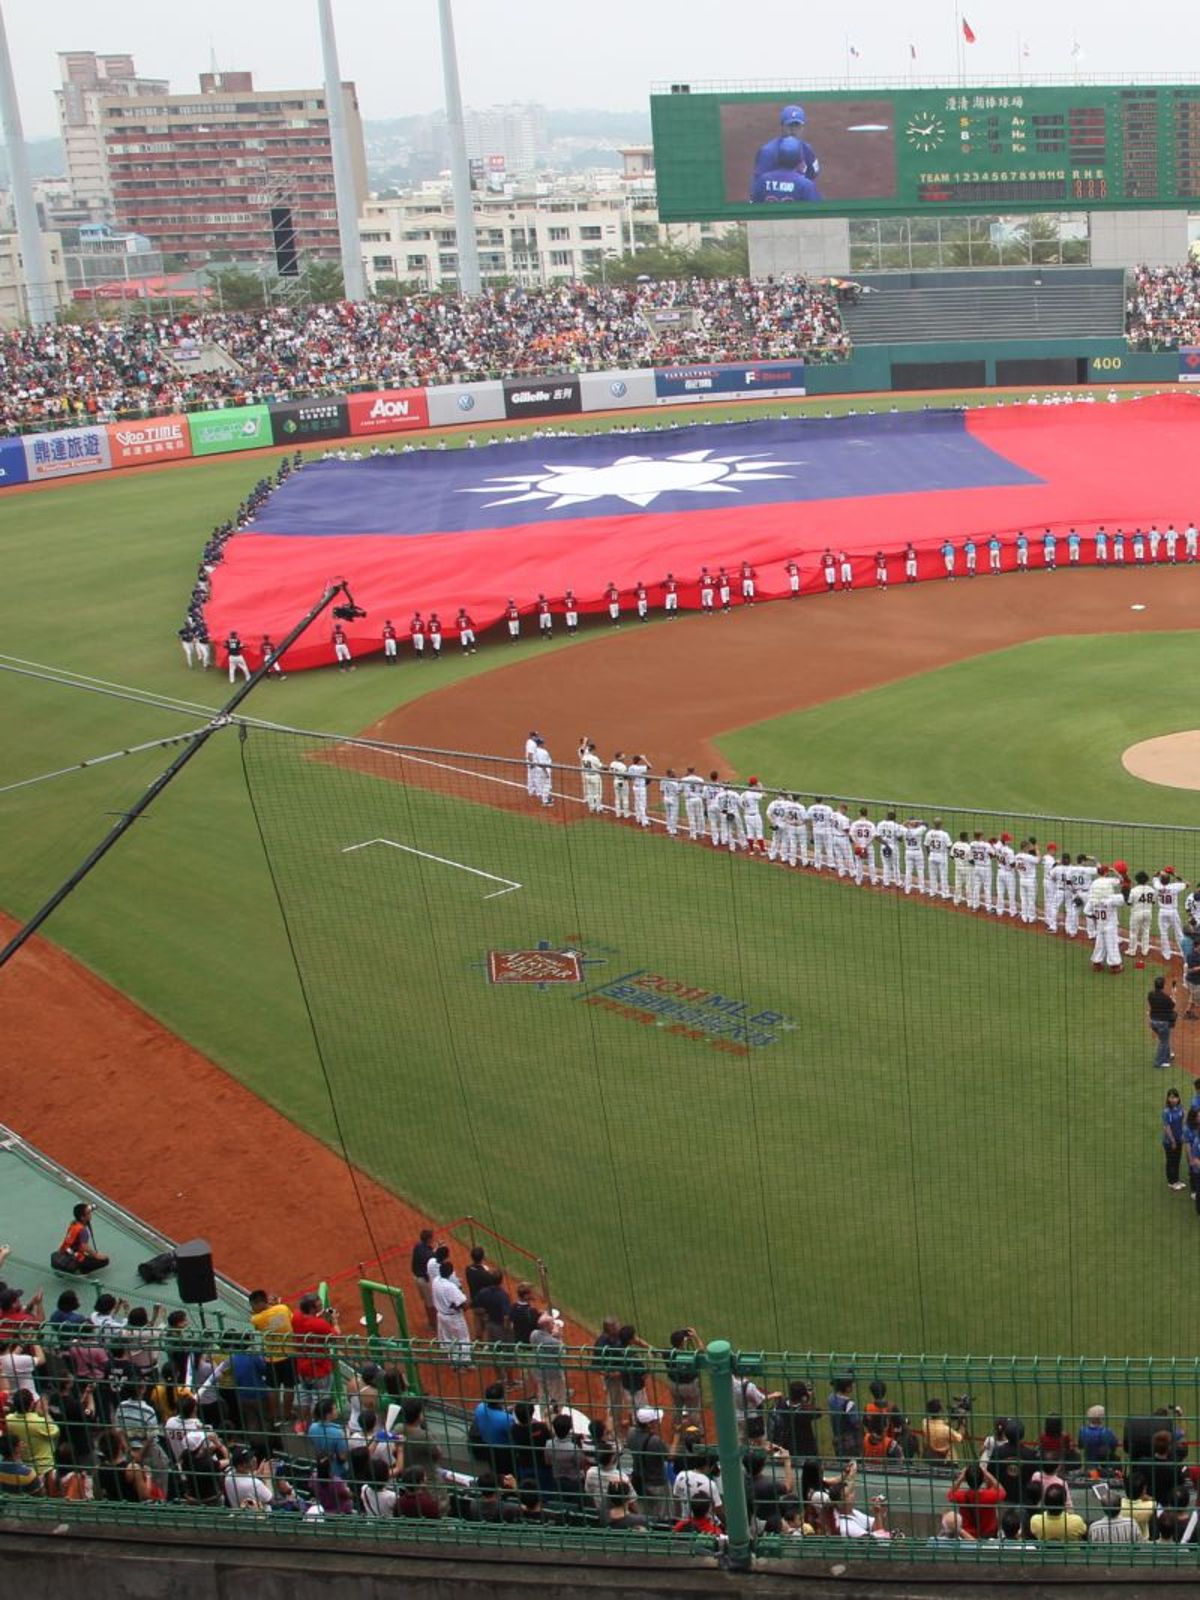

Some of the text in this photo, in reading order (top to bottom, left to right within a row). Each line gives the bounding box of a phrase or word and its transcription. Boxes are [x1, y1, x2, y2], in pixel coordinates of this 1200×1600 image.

[920, 173, 950, 183] TEAM
[1092, 357, 1121, 370] 400
[511, 391, 550, 403] Gillette
[953, 848, 965, 860] 52
[1140, 893, 1153, 903] 48
